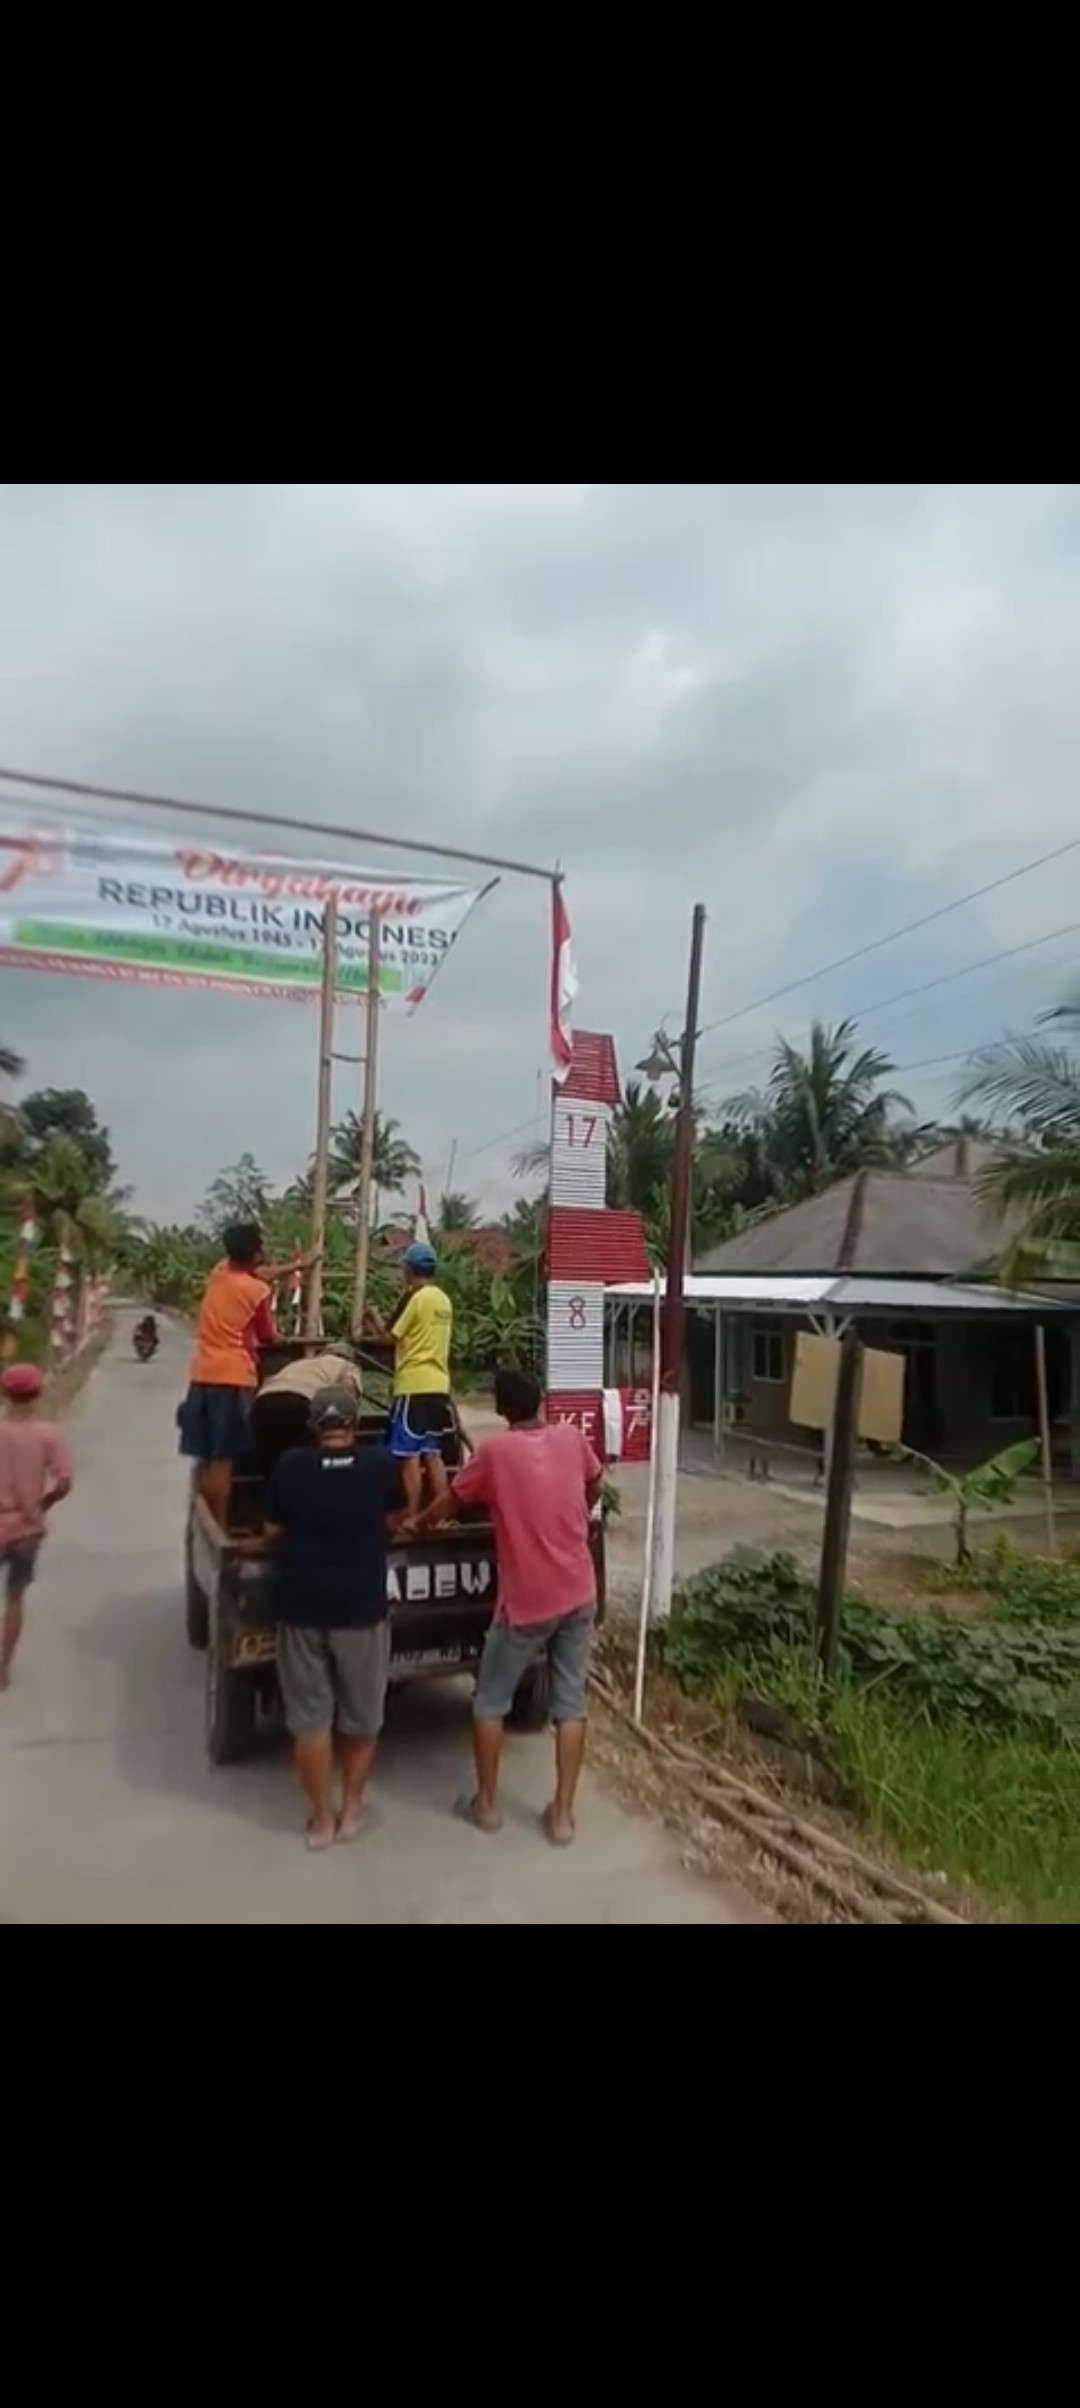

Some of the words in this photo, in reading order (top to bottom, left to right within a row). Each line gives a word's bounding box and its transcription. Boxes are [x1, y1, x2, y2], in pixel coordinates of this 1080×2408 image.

[98, 876, 284, 928] REPUBLIK
[566, 1114, 597, 1148] 17
[569, 1296, 586, 1330] 8
